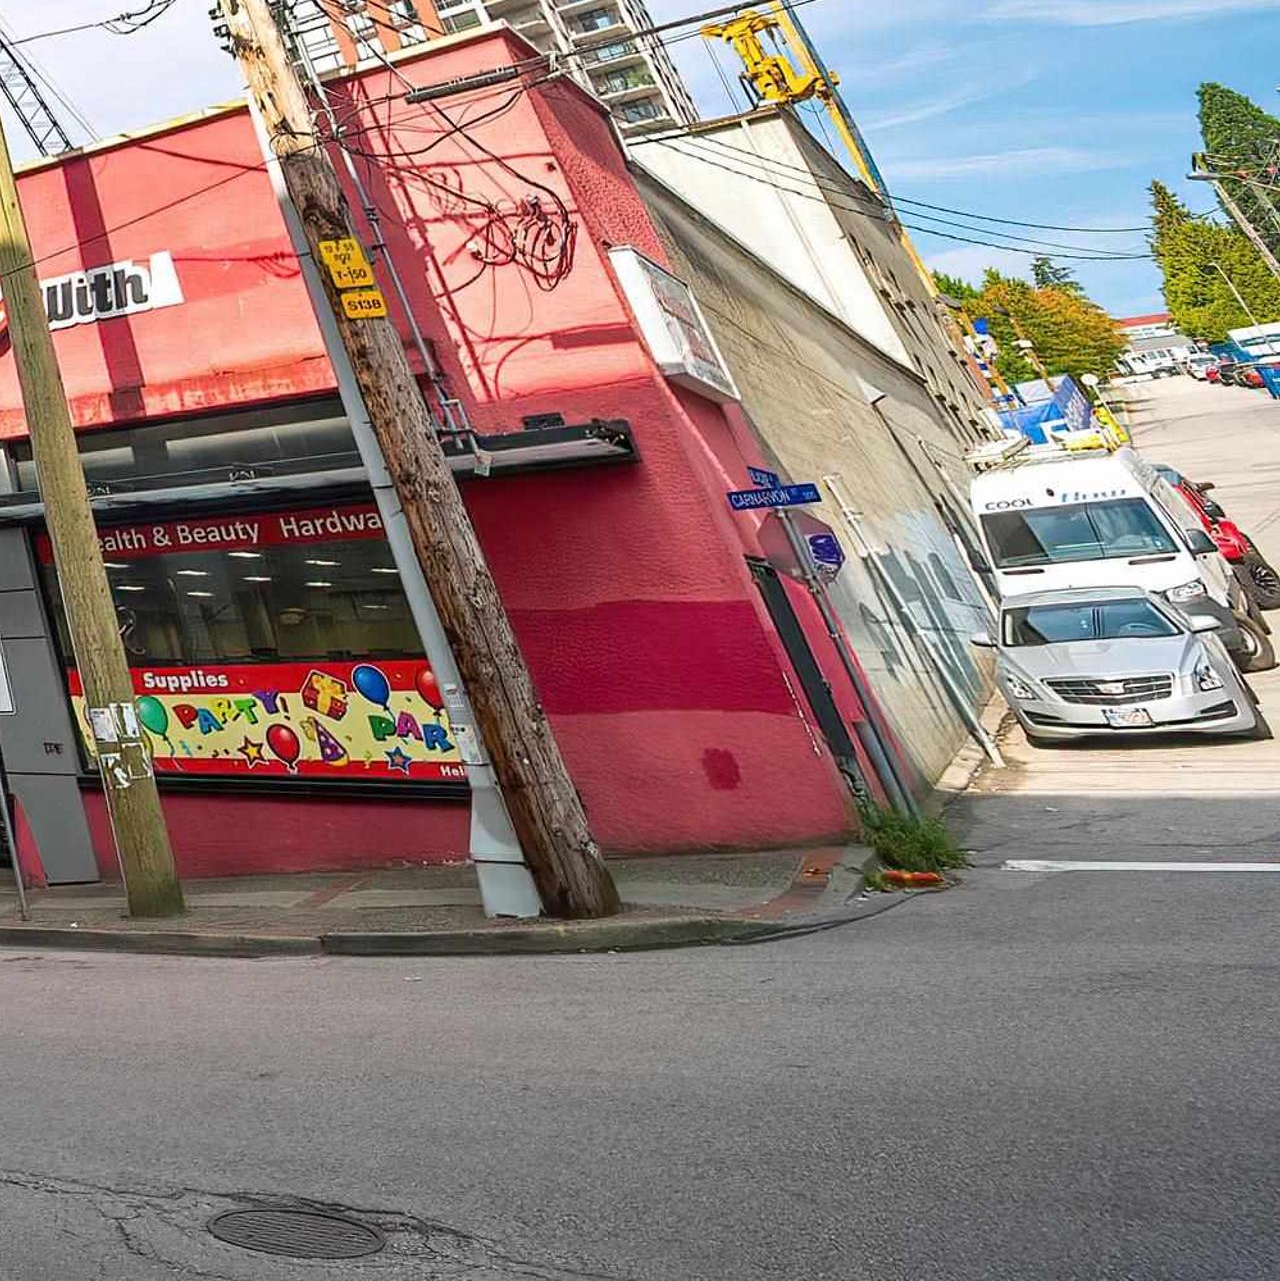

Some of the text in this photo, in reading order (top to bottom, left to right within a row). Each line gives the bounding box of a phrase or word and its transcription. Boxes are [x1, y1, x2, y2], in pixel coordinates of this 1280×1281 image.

[98, 510, 383, 552] ealth & Beauty Hardwa
[143, 670, 229, 694] Supplies
[172, 689, 456, 754] PARTY! PAR
